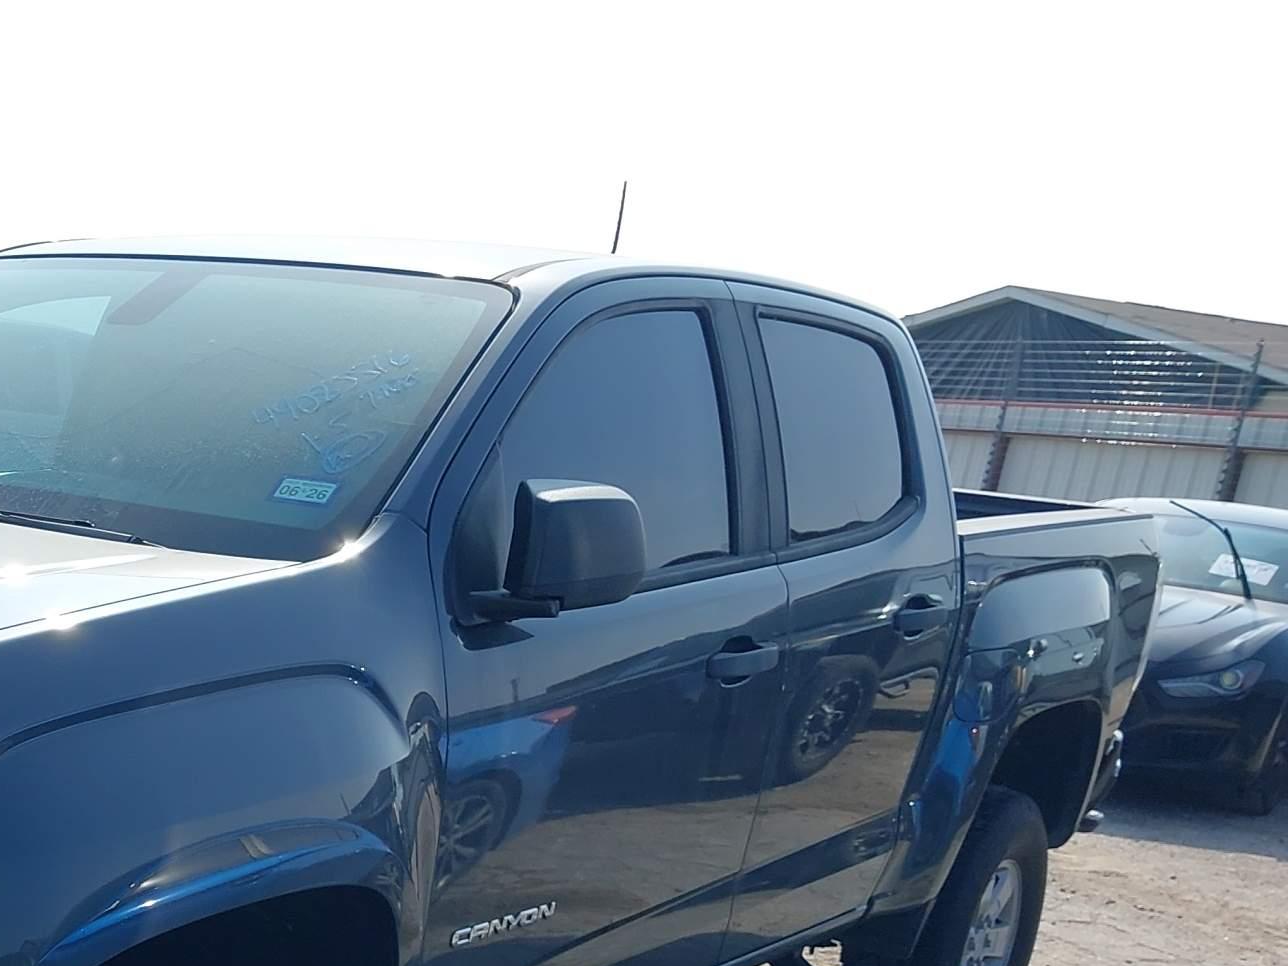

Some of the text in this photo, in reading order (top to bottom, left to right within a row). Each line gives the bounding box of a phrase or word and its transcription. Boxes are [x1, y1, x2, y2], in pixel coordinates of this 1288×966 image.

[279, 485, 301, 496] 06
[305, 488, 329, 500] 26
[451, 901, 557, 946] CANYON
